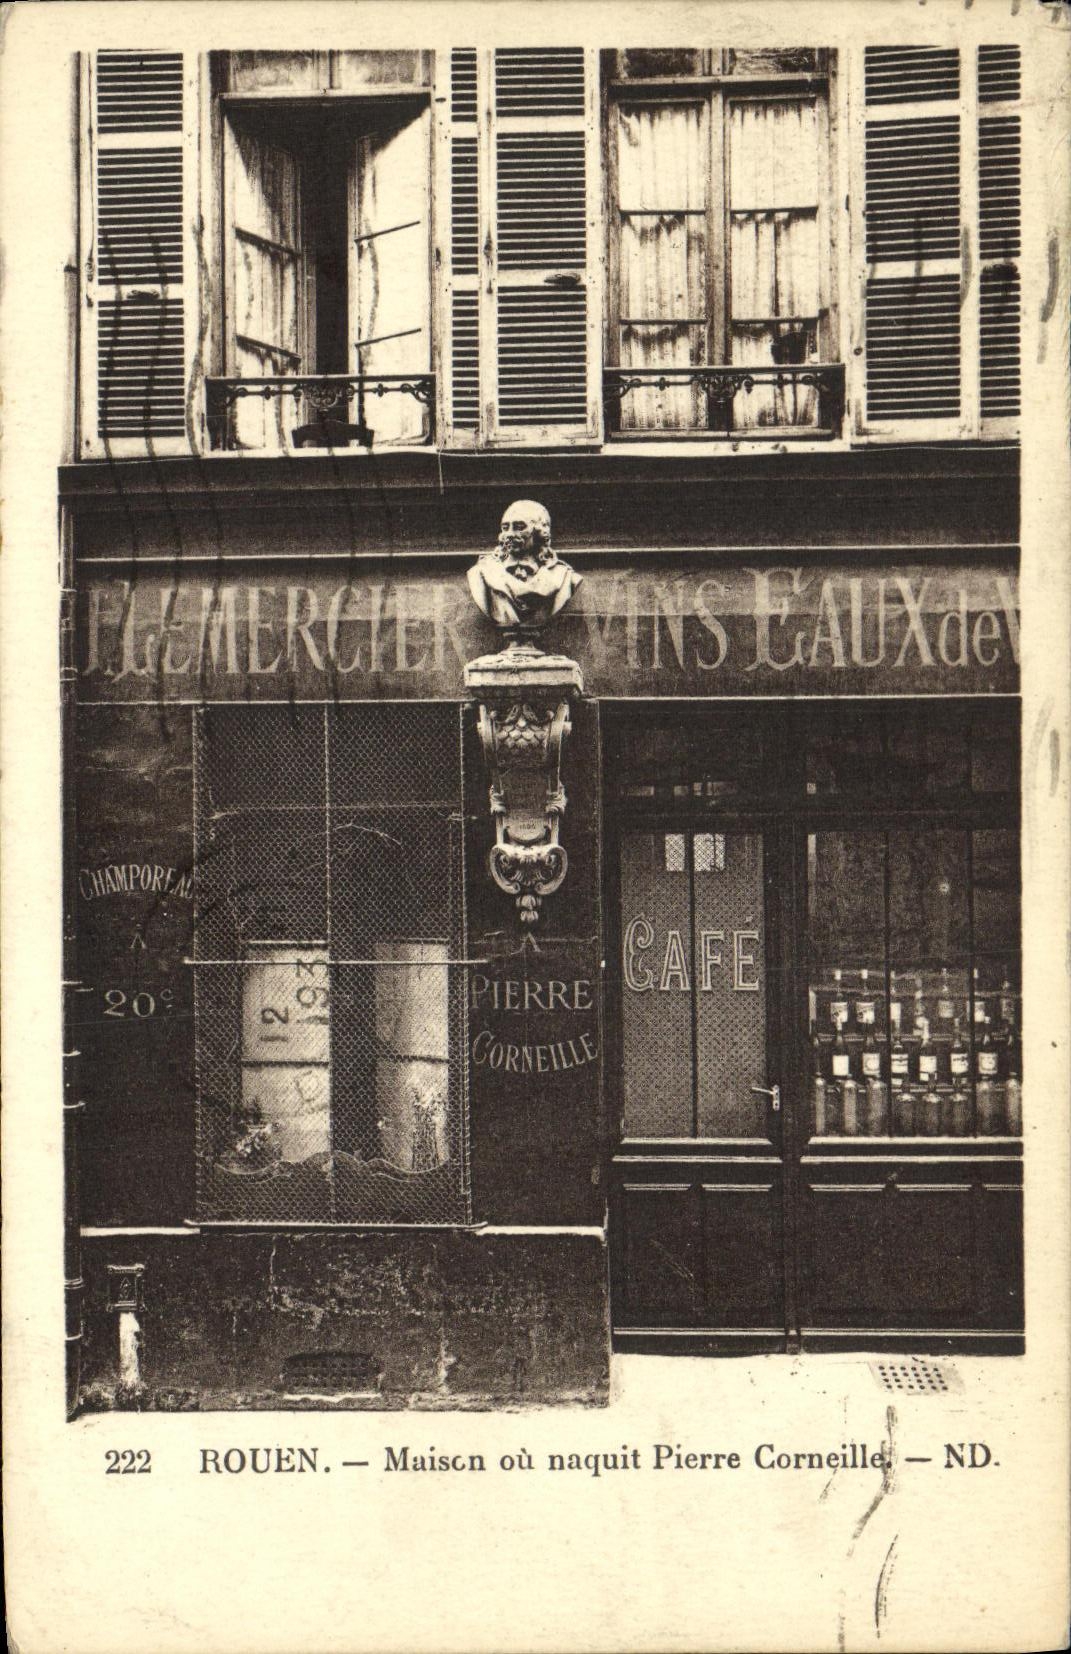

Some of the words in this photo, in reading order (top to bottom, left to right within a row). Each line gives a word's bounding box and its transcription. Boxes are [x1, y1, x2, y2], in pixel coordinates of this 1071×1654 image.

[111, 581, 469, 683] LEMERCIER
[582, 571, 732, 672] VINS
[743, 567, 937, 672] EAUX
[938, 588, 1000, 667] de
[472, 974, 594, 1011] PIERRE
[472, 1030, 600, 1073] CORNEILLE
